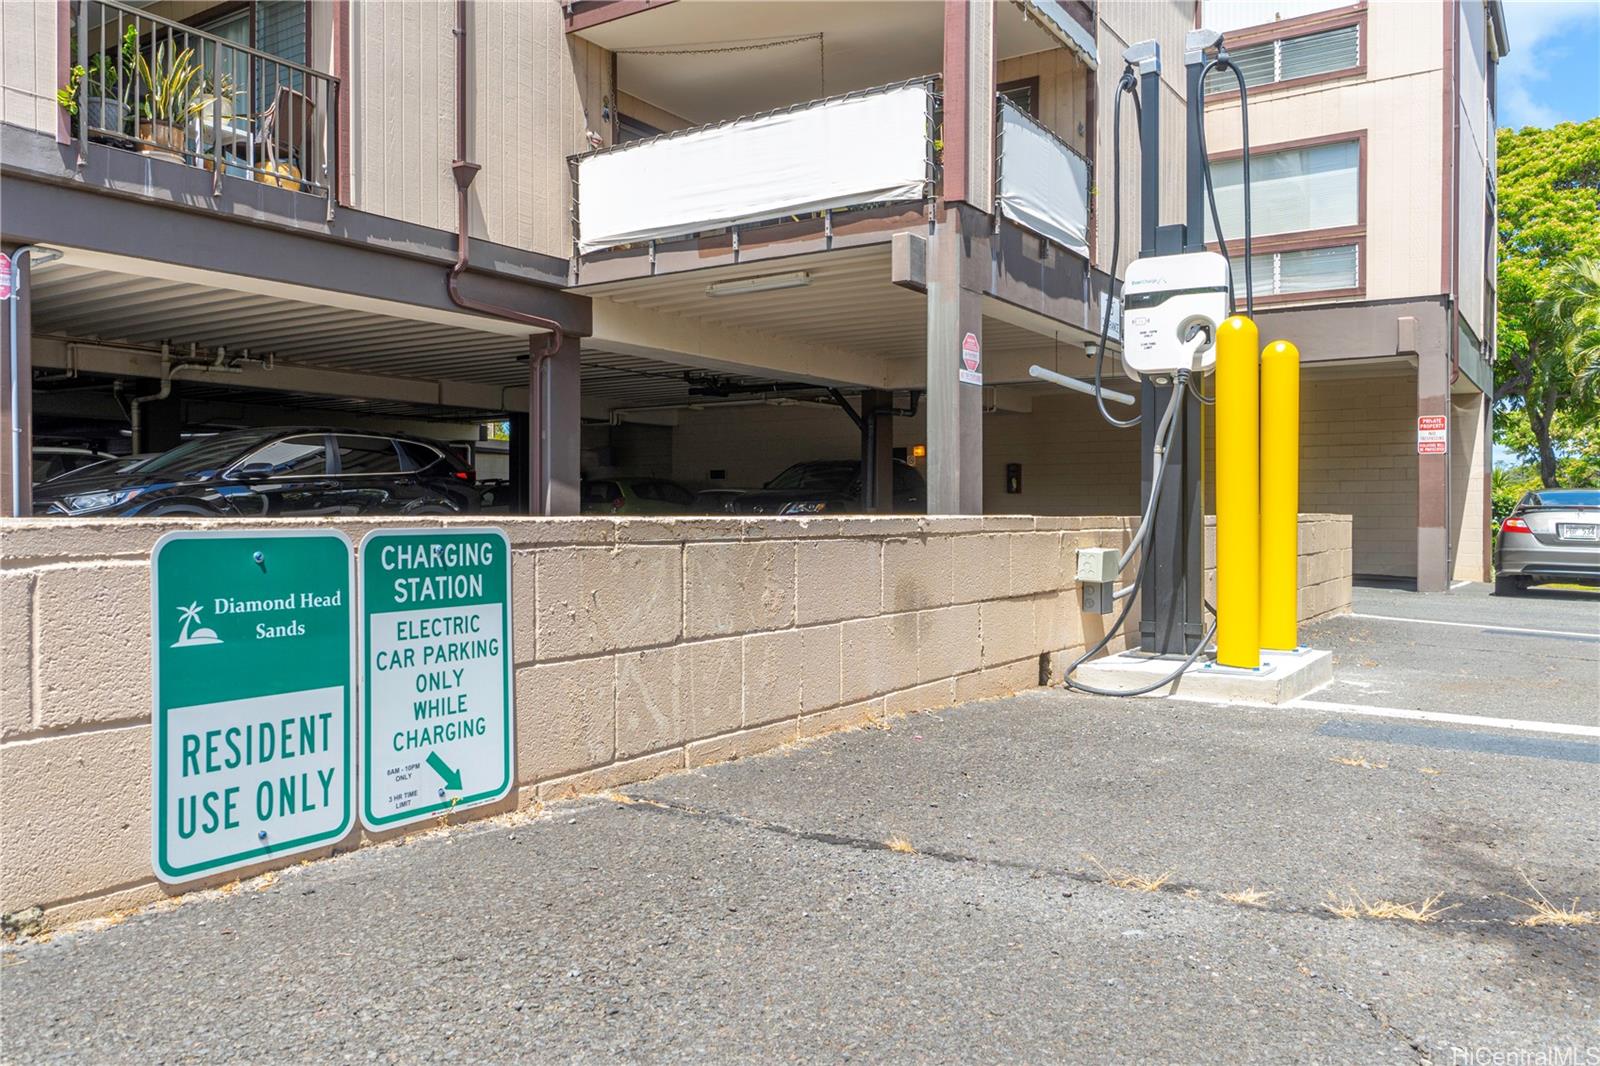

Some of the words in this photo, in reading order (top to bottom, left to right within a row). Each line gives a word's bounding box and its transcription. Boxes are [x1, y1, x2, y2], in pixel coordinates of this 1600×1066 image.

[381, 542, 493, 571] CHARGING
[394, 574, 483, 603] STATION
[214, 592, 295, 615] Diamond
[300, 589, 342, 608] Head
[256, 620, 305, 639] Sands
[397, 615, 480, 641] ELECTRIC
[376, 648, 415, 671] CAR
[423, 638, 499, 665] PARKING
[416, 668, 464, 693] ONLY
[414, 694, 467, 721] WHILE
[182, 712, 332, 778] RESIDENT
[393, 717, 486, 752] CHARGING
[395, 773, 412, 782] ONLY
[405, 763, 421, 772] 10PM
[178, 786, 240, 840] USE
[256, 767, 335, 822] ONLY
[394, 793, 402, 801] HR
[404, 790, 418, 798] TIME
[395, 800, 411, 809] LIMIT
